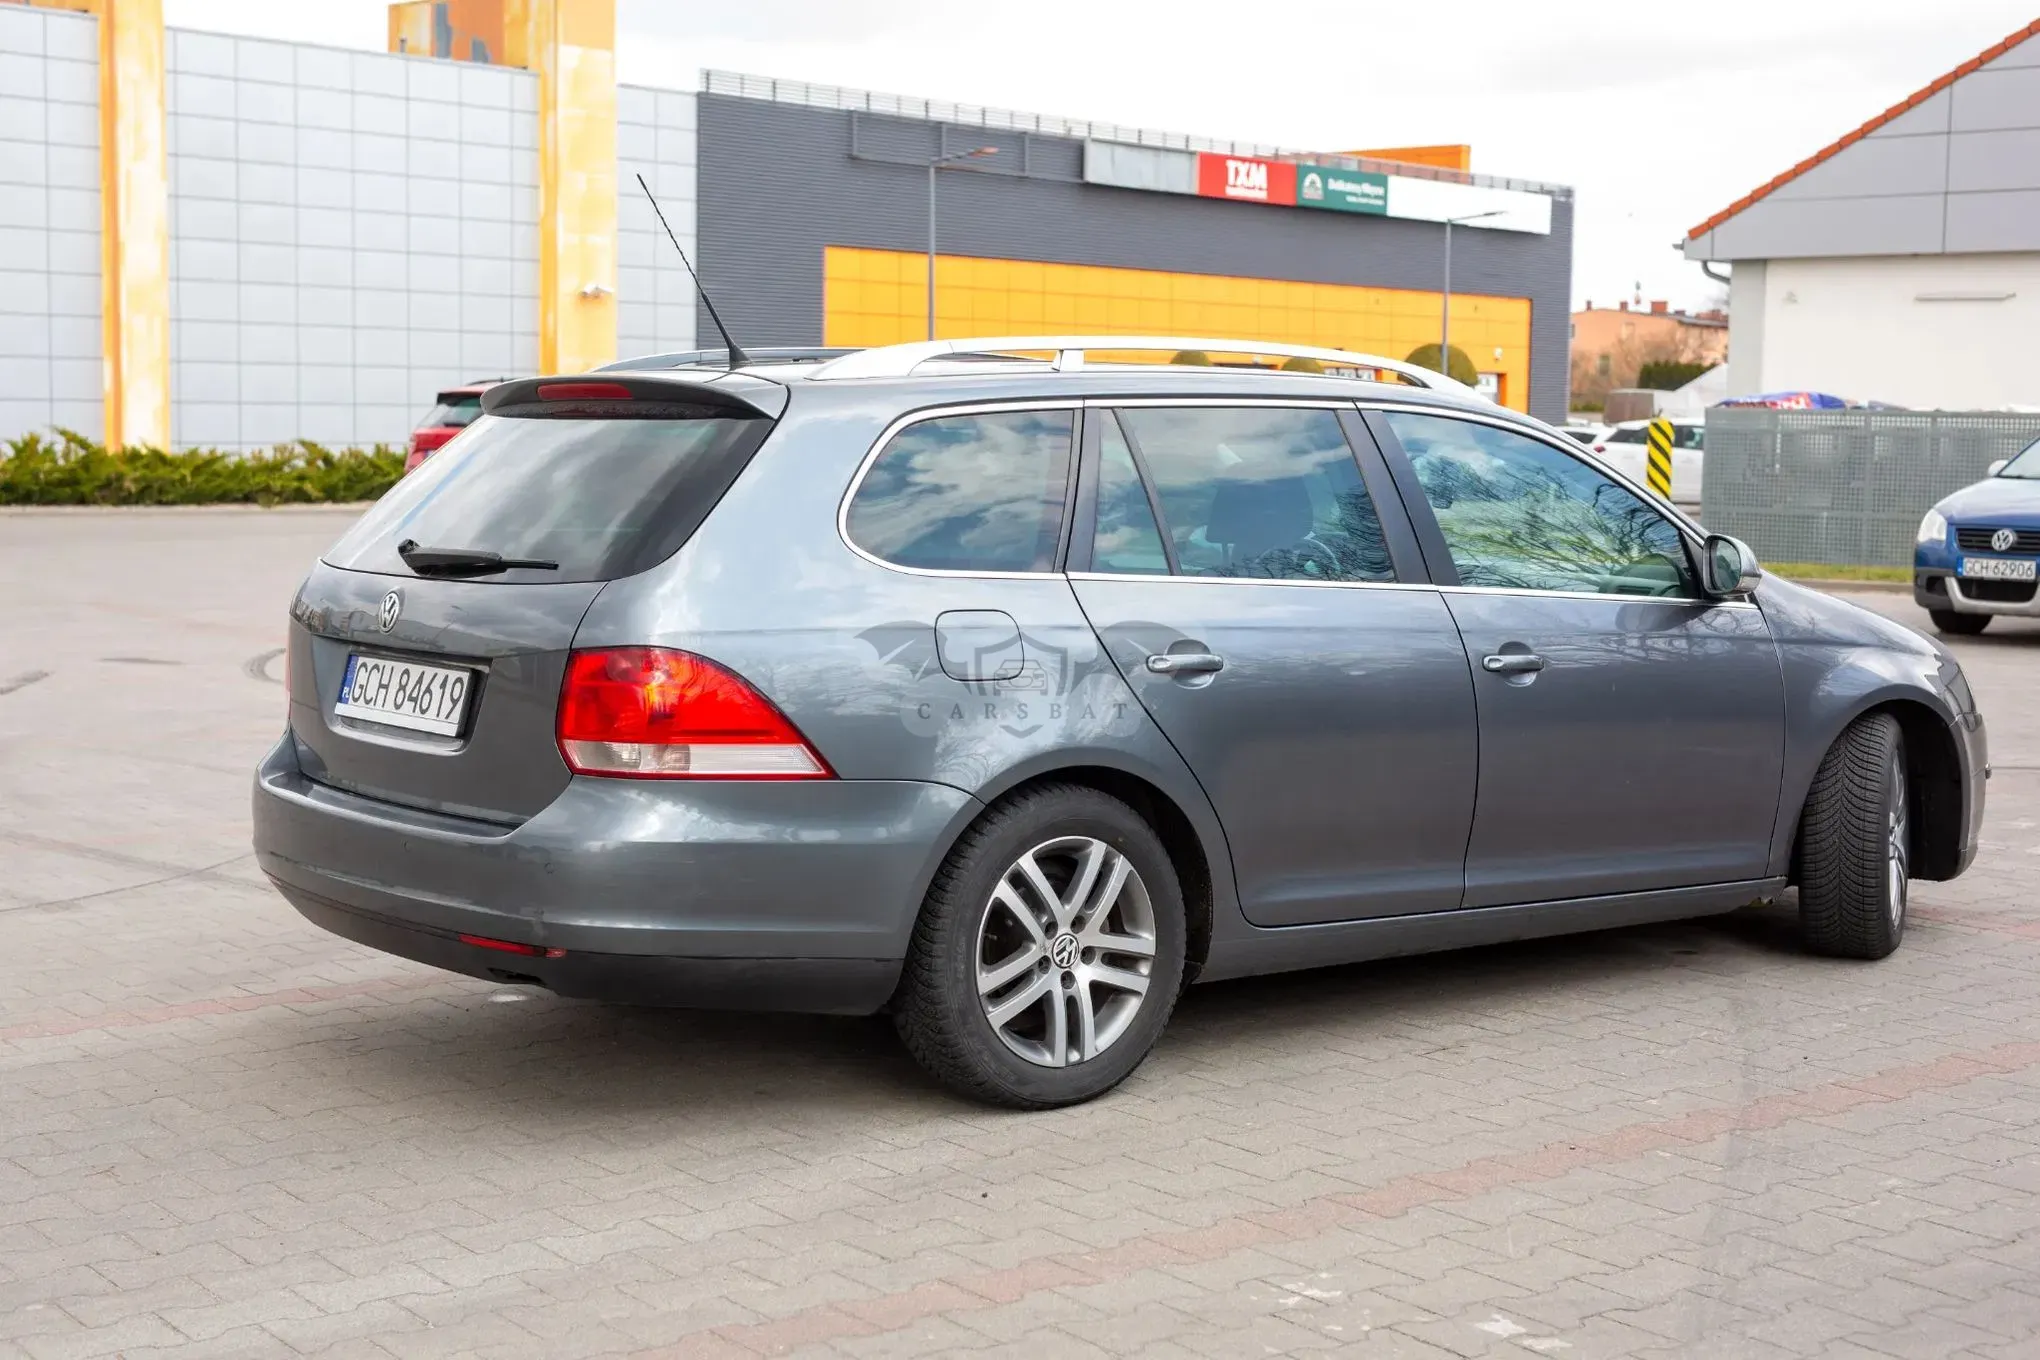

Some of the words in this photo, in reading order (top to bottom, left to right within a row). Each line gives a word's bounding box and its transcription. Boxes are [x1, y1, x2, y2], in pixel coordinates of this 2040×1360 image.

[1225, 159, 1268, 189] TXM
[1965, 560, 1989, 575] GCH
[1992, 561, 2034, 578] 62906
[351, 661, 394, 708] GCH
[393, 667, 465, 720] 84619
